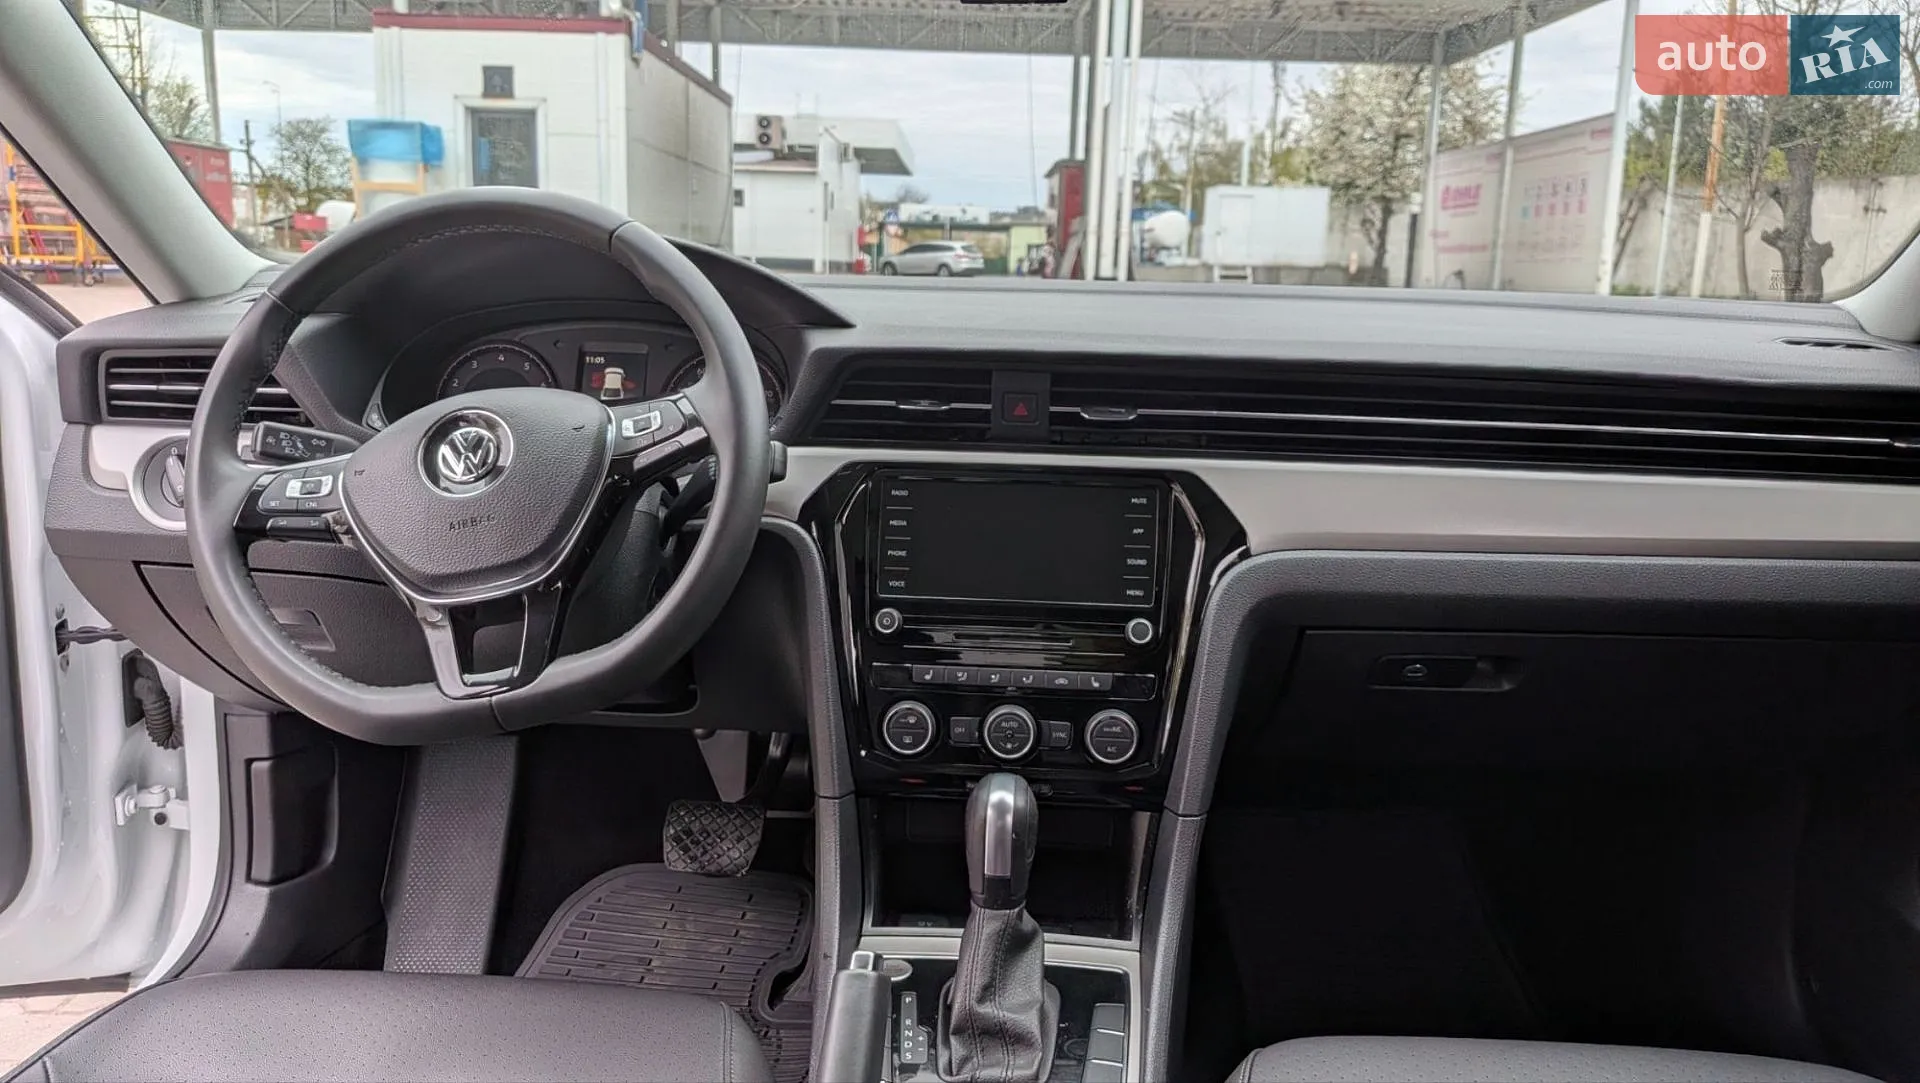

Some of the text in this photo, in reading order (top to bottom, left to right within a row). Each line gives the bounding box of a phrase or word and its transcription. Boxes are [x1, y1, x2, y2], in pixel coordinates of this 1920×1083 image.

[585, 356, 605, 364] 11:05
[523, 361, 530, 370] 5
[452, 379, 459, 387] 2
[888, 549, 908, 557] PHONE
[905, 1018, 912, 1026] R
[905, 1052, 912, 1060] S
